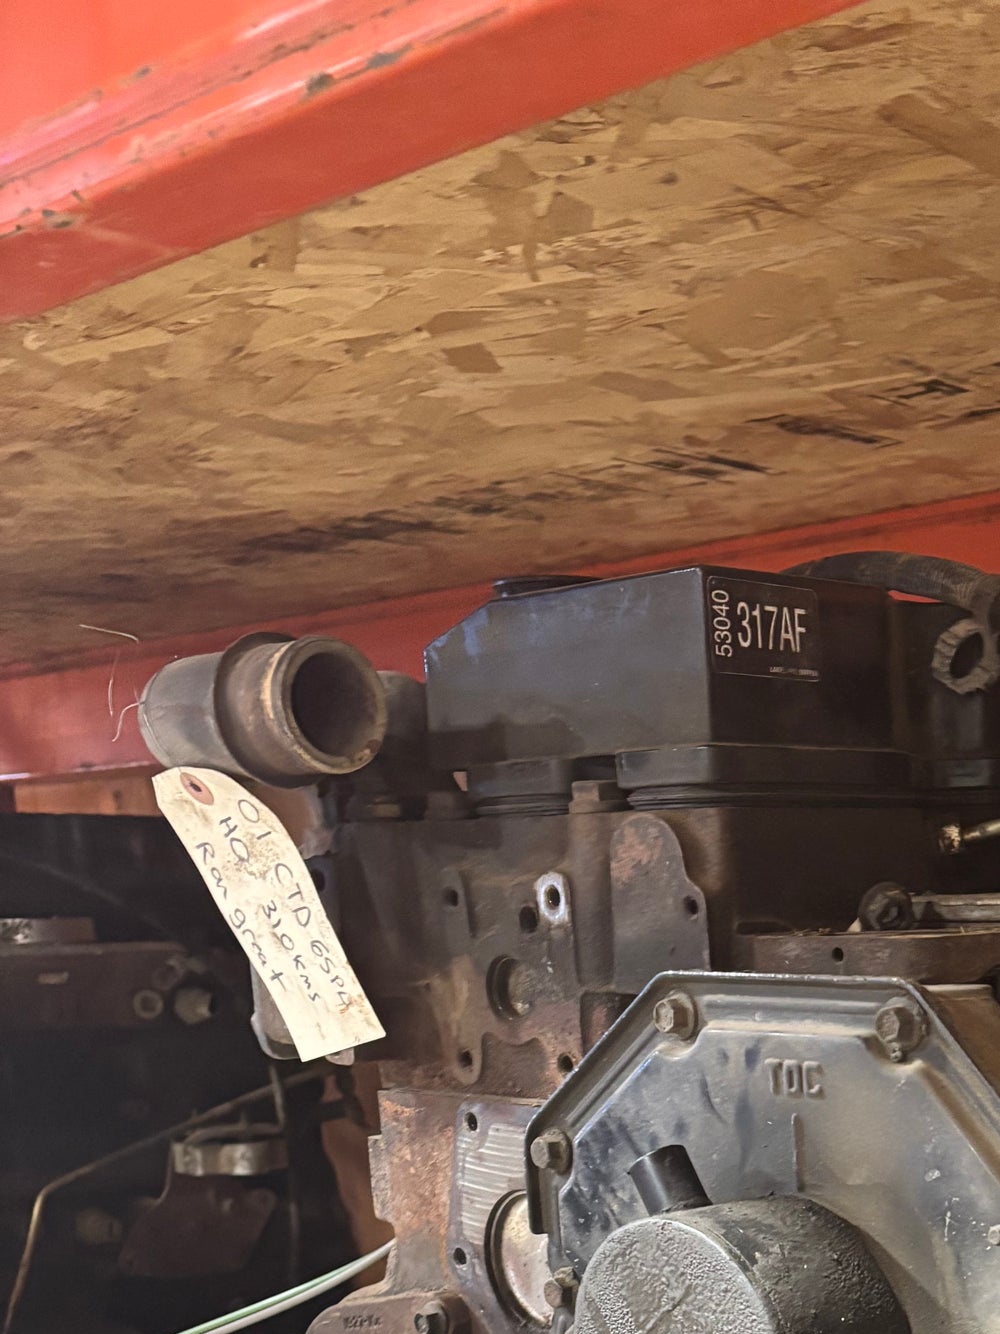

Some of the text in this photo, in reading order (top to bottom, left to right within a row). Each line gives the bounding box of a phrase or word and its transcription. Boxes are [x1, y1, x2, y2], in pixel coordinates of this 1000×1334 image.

[711, 589, 733, 658] 53040
[736, 601, 807, 653] 317AF
[275, 863, 311, 927] CTD
[764, 1057, 825, 1100] TDC
